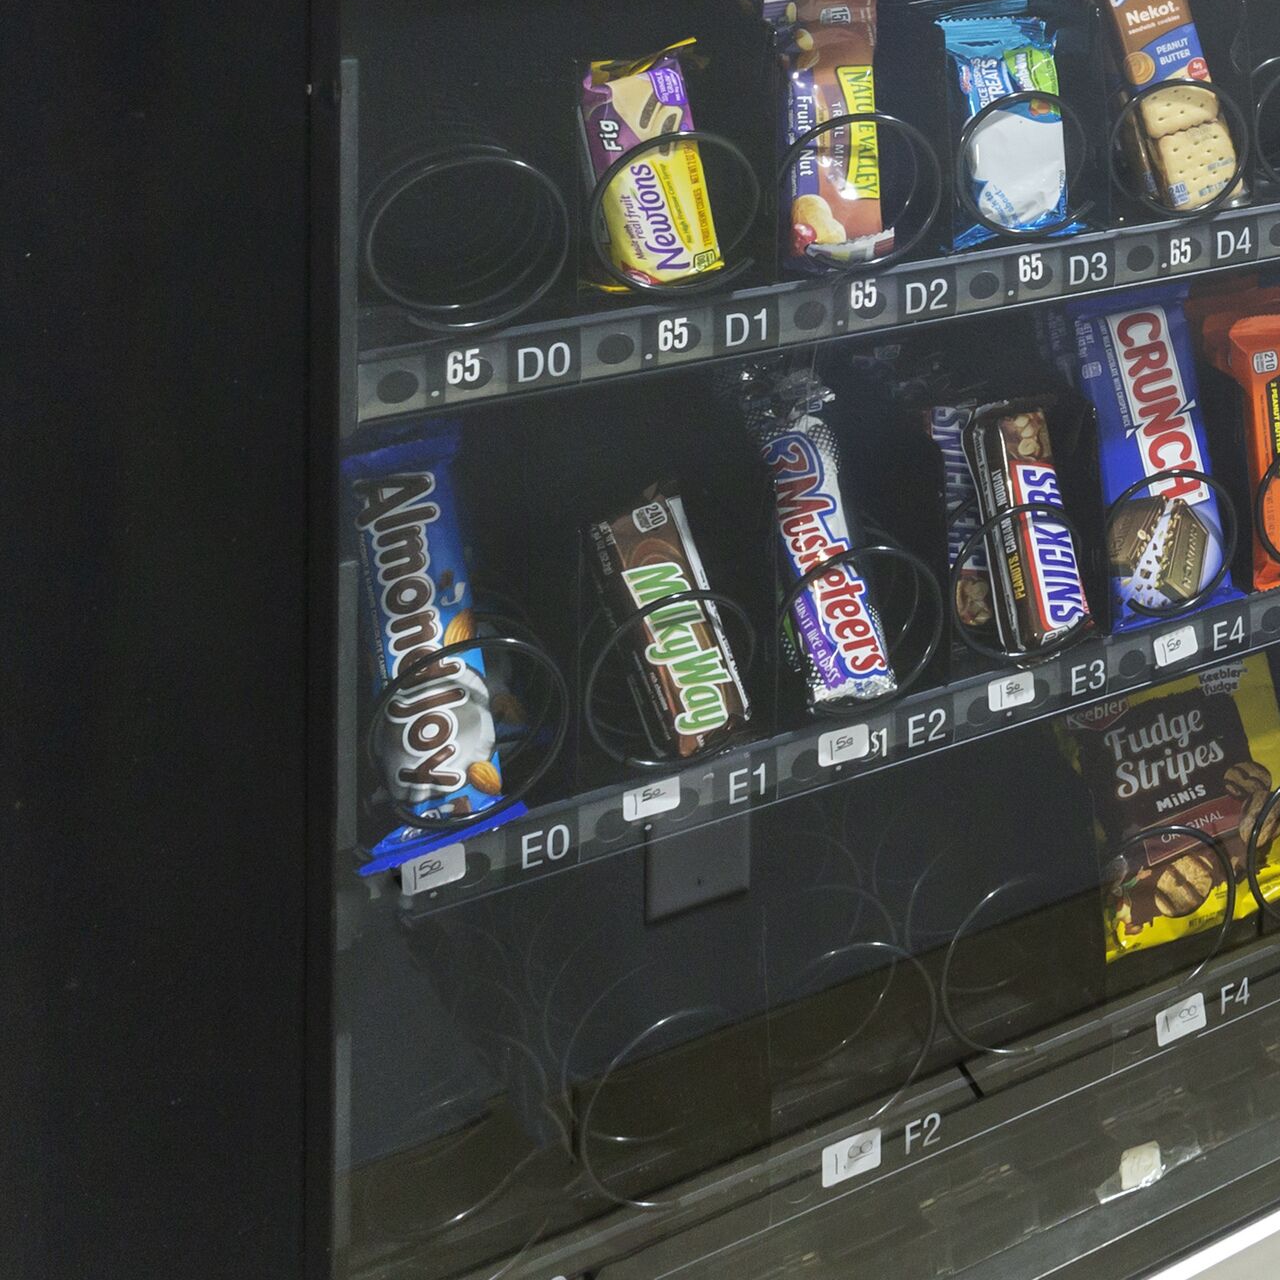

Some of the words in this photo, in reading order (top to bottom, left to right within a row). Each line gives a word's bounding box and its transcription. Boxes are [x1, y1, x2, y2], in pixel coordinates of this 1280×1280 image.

[1125, 0, 1176, 26] Nekot
[1155, 37, 1189, 55] PEANUT
[1158, 48, 1192, 66] BUTTER
[796, 95, 812, 133] Fruit
[599, 119, 624, 152] Fig
[799, 148, 814, 177] Nut
[834, 144, 845, 168] MIX
[854, 135, 879, 195] VALLEY
[630, 162, 691, 271] Newtons
[1216, 228, 1252, 260] D4
[1069, 251, 1108, 284] D3
[905, 279, 949, 314] D2
[725, 307, 770, 345] D1
[517, 342, 572, 382] D0
[1116, 312, 1203, 499] CRUNCH
[645, 504, 665, 526] 240
[354, 471, 466, 690] Almond
[1212, 616, 1246, 650] E4
[670, 645, 733, 735] Way
[1070, 659, 1107, 695] E3
[386, 685, 470, 792] Joy
[907, 709, 946, 748] E2
[1104, 707, 1205, 761] Fudge
[729, 764, 767, 803] E1
[1115, 739, 1225, 799] Stripes
[521, 829, 570, 868] E0
[1219, 977, 1252, 1013] F4
[905, 1114, 943, 1153] F2
